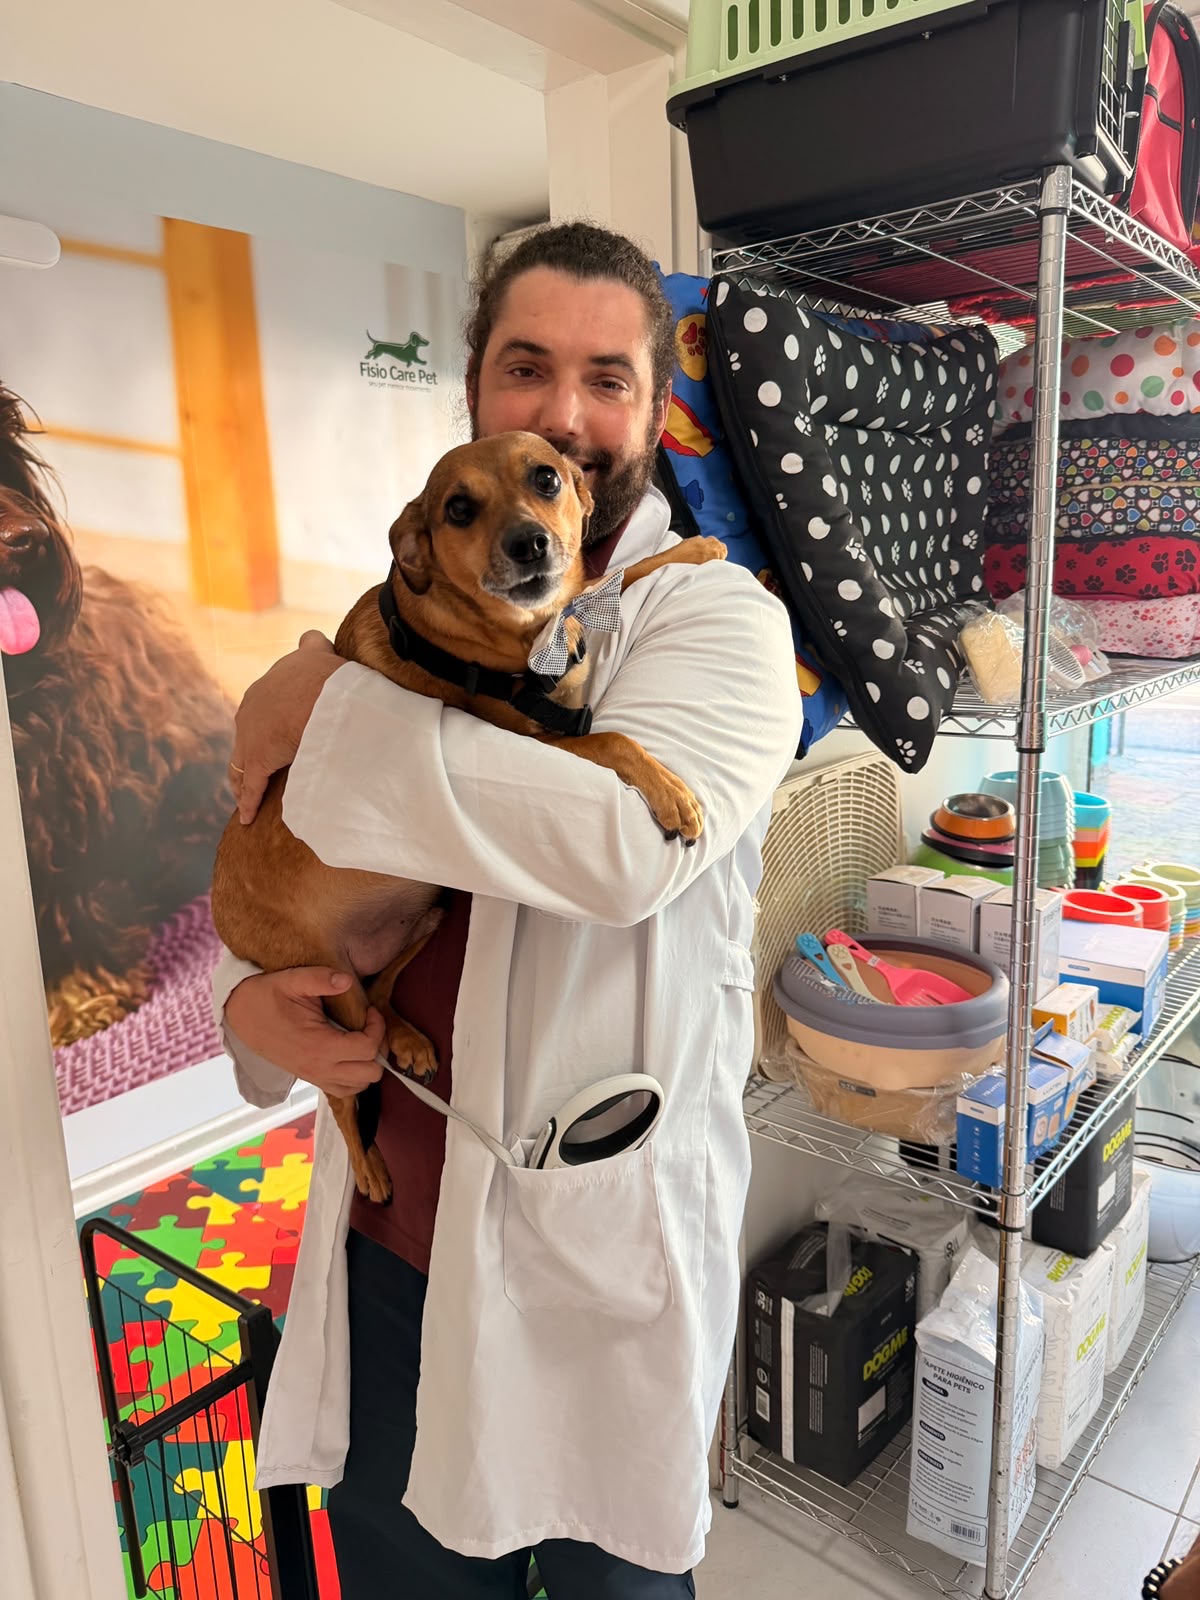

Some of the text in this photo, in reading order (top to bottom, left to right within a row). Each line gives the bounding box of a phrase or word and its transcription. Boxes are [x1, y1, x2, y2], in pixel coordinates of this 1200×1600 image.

[360, 362, 438, 385] Fisio Care Pet
[1103, 1118, 1132, 1162] DOGME
[1046, 1252, 1075, 1283] OGME
[863, 1327, 909, 1381] DOGME
[923, 1358, 985, 1391] TAPETE HIGIÊNICO
[932, 1373, 971, 1394] PARA PETS
